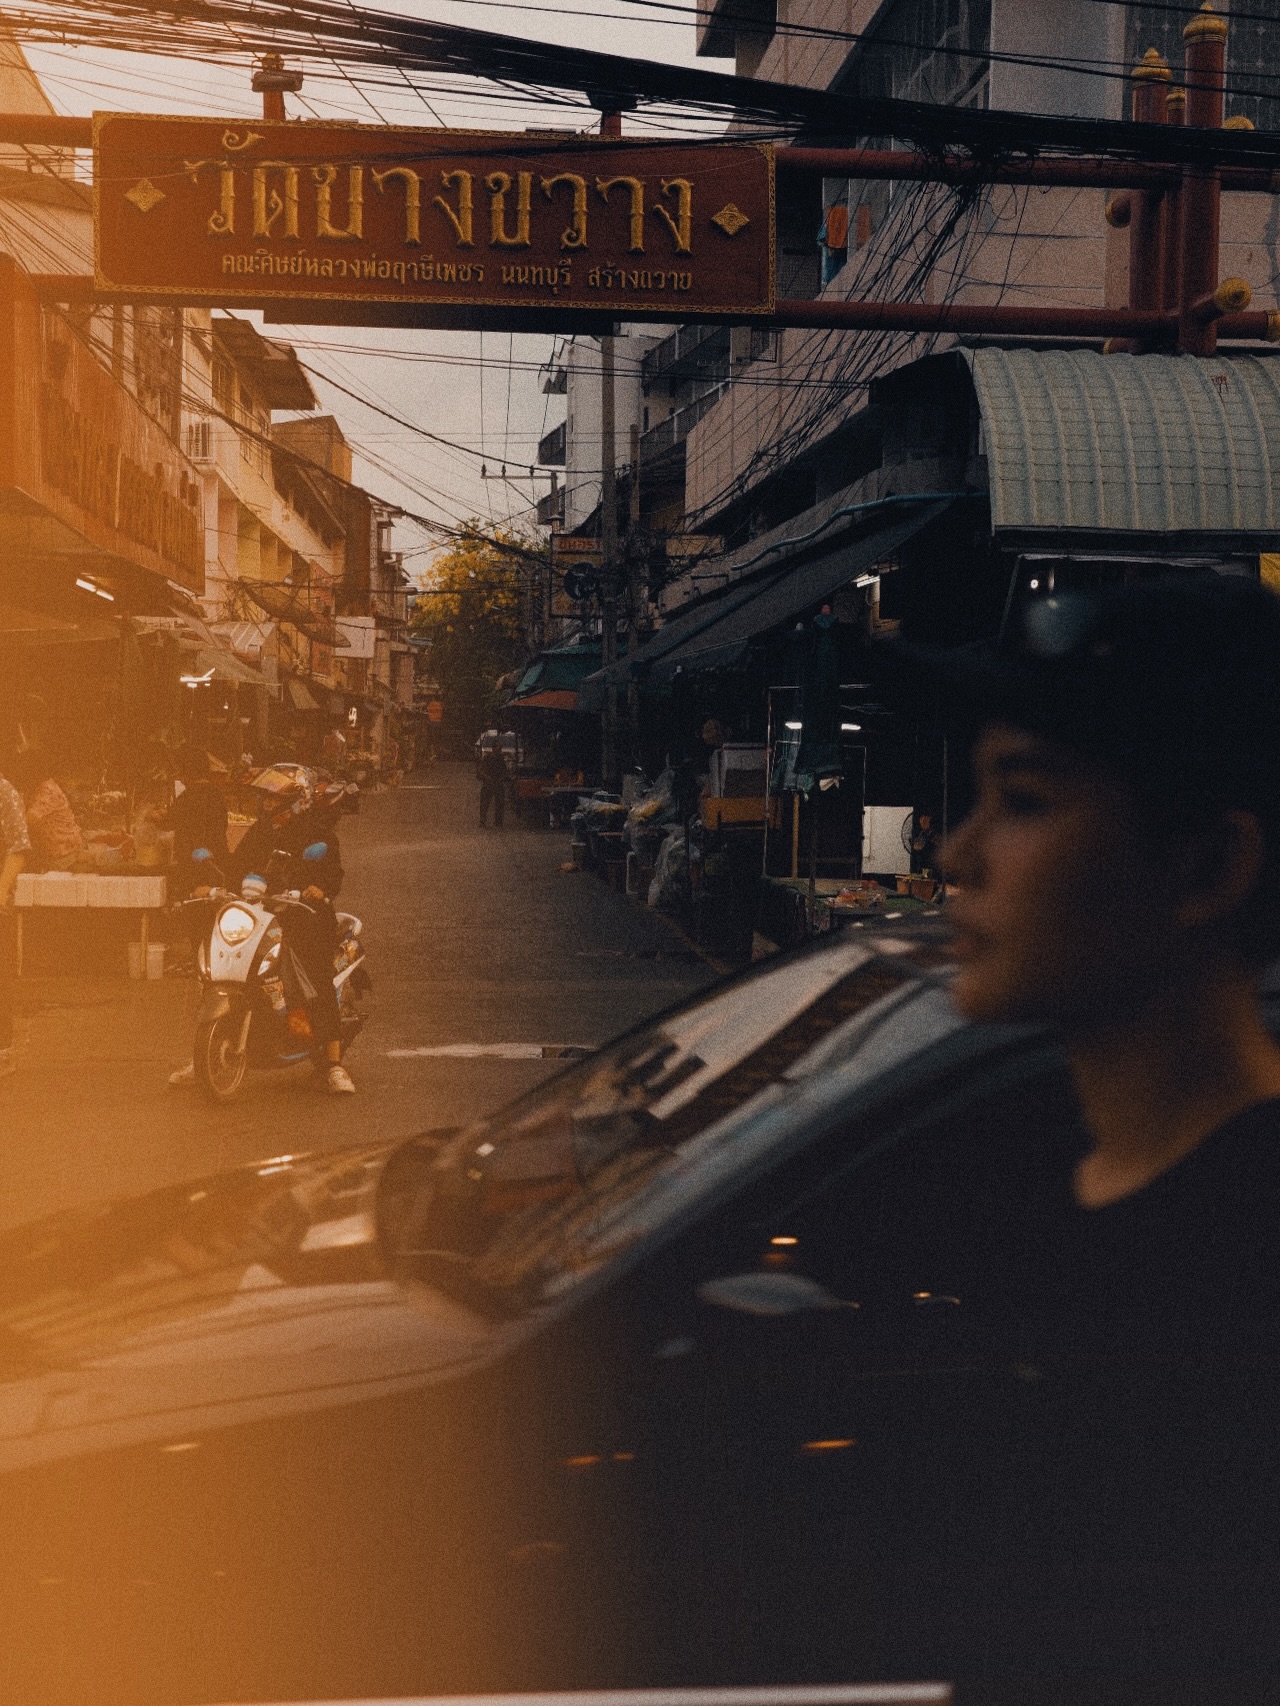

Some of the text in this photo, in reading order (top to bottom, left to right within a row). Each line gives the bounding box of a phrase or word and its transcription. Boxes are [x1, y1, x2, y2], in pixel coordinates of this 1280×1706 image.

[184, 129, 694, 252] วัดบางขวาง
[501, 258, 572, 295] นนทบุรี
[588, 261, 693, 290] สร้างถวาย
